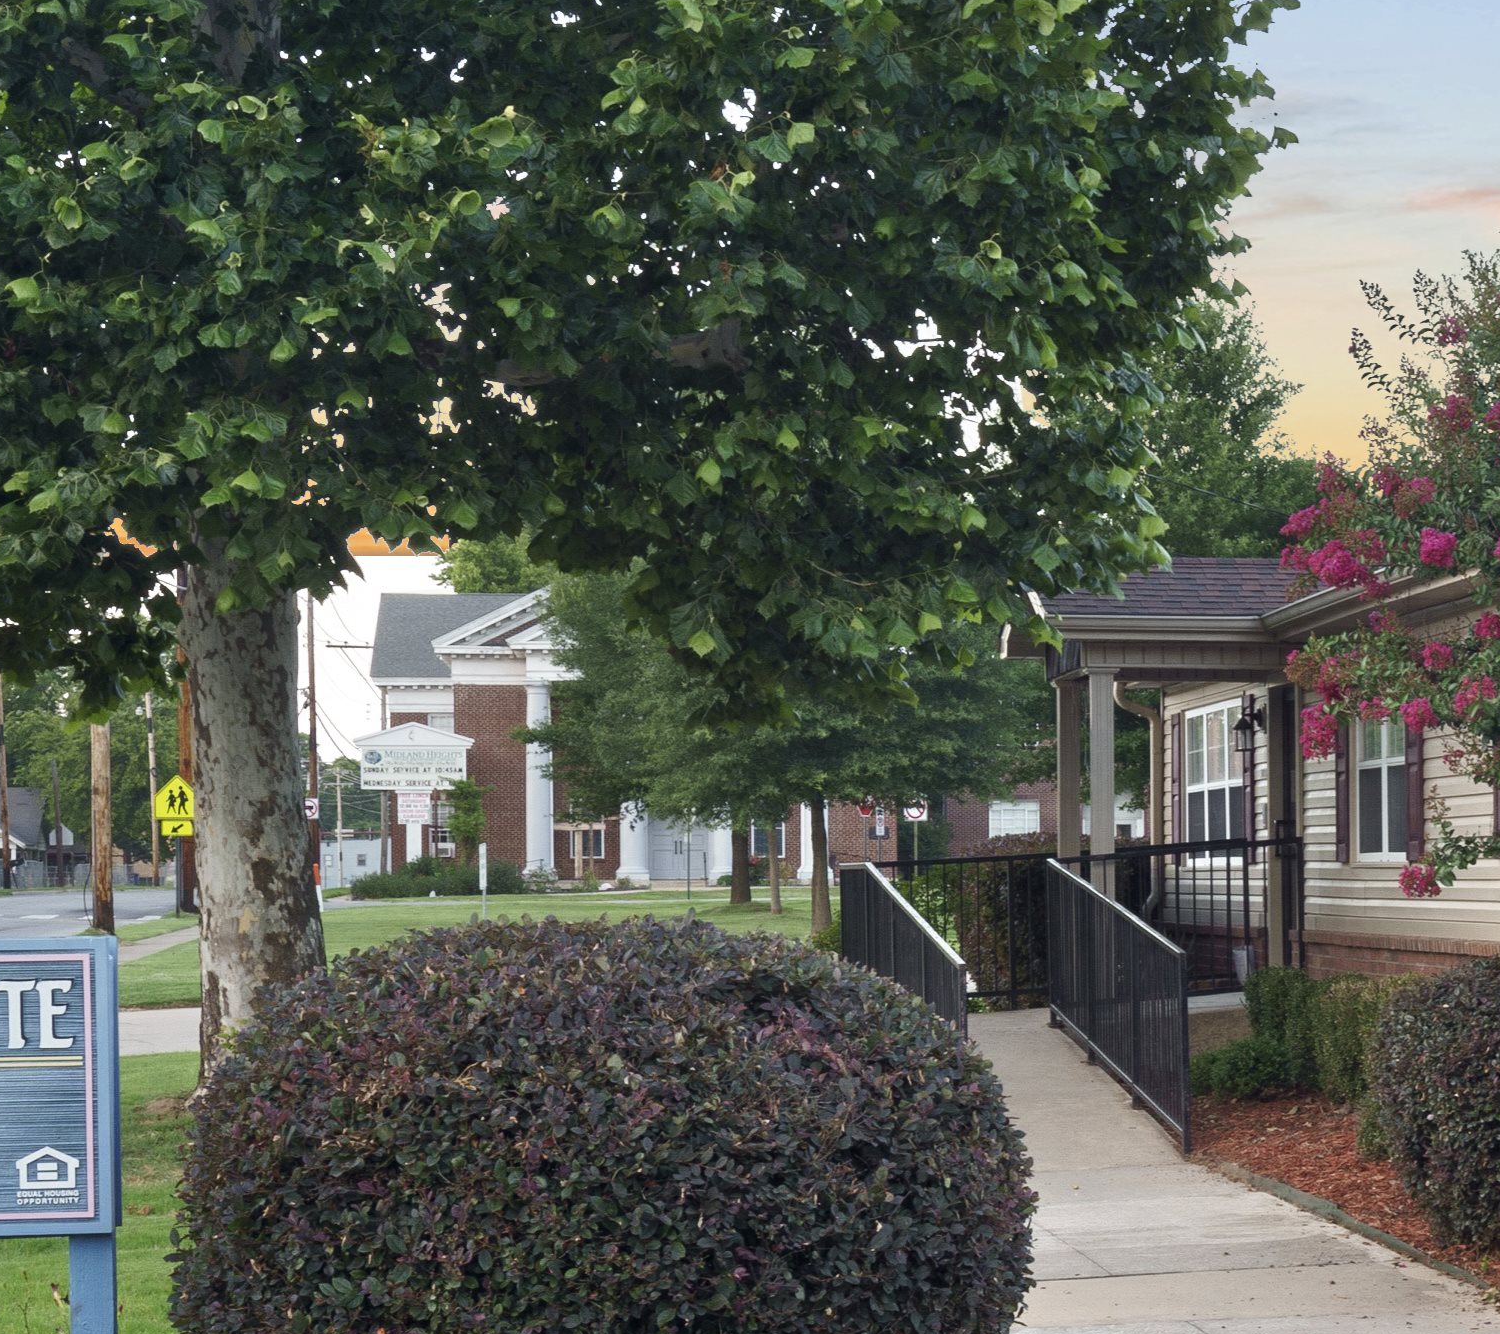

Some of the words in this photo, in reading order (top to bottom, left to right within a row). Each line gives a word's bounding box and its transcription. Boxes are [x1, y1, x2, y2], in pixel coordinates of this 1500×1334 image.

[385, 750, 425, 759] MIDLAND
[426, 750, 463, 759] HEIGHTS
[16, 1190, 43, 1198] EQUAL
[44, 1189, 80, 1197] HOUSING
[16, 1197, 80, 1205] OPPORTUNITY
